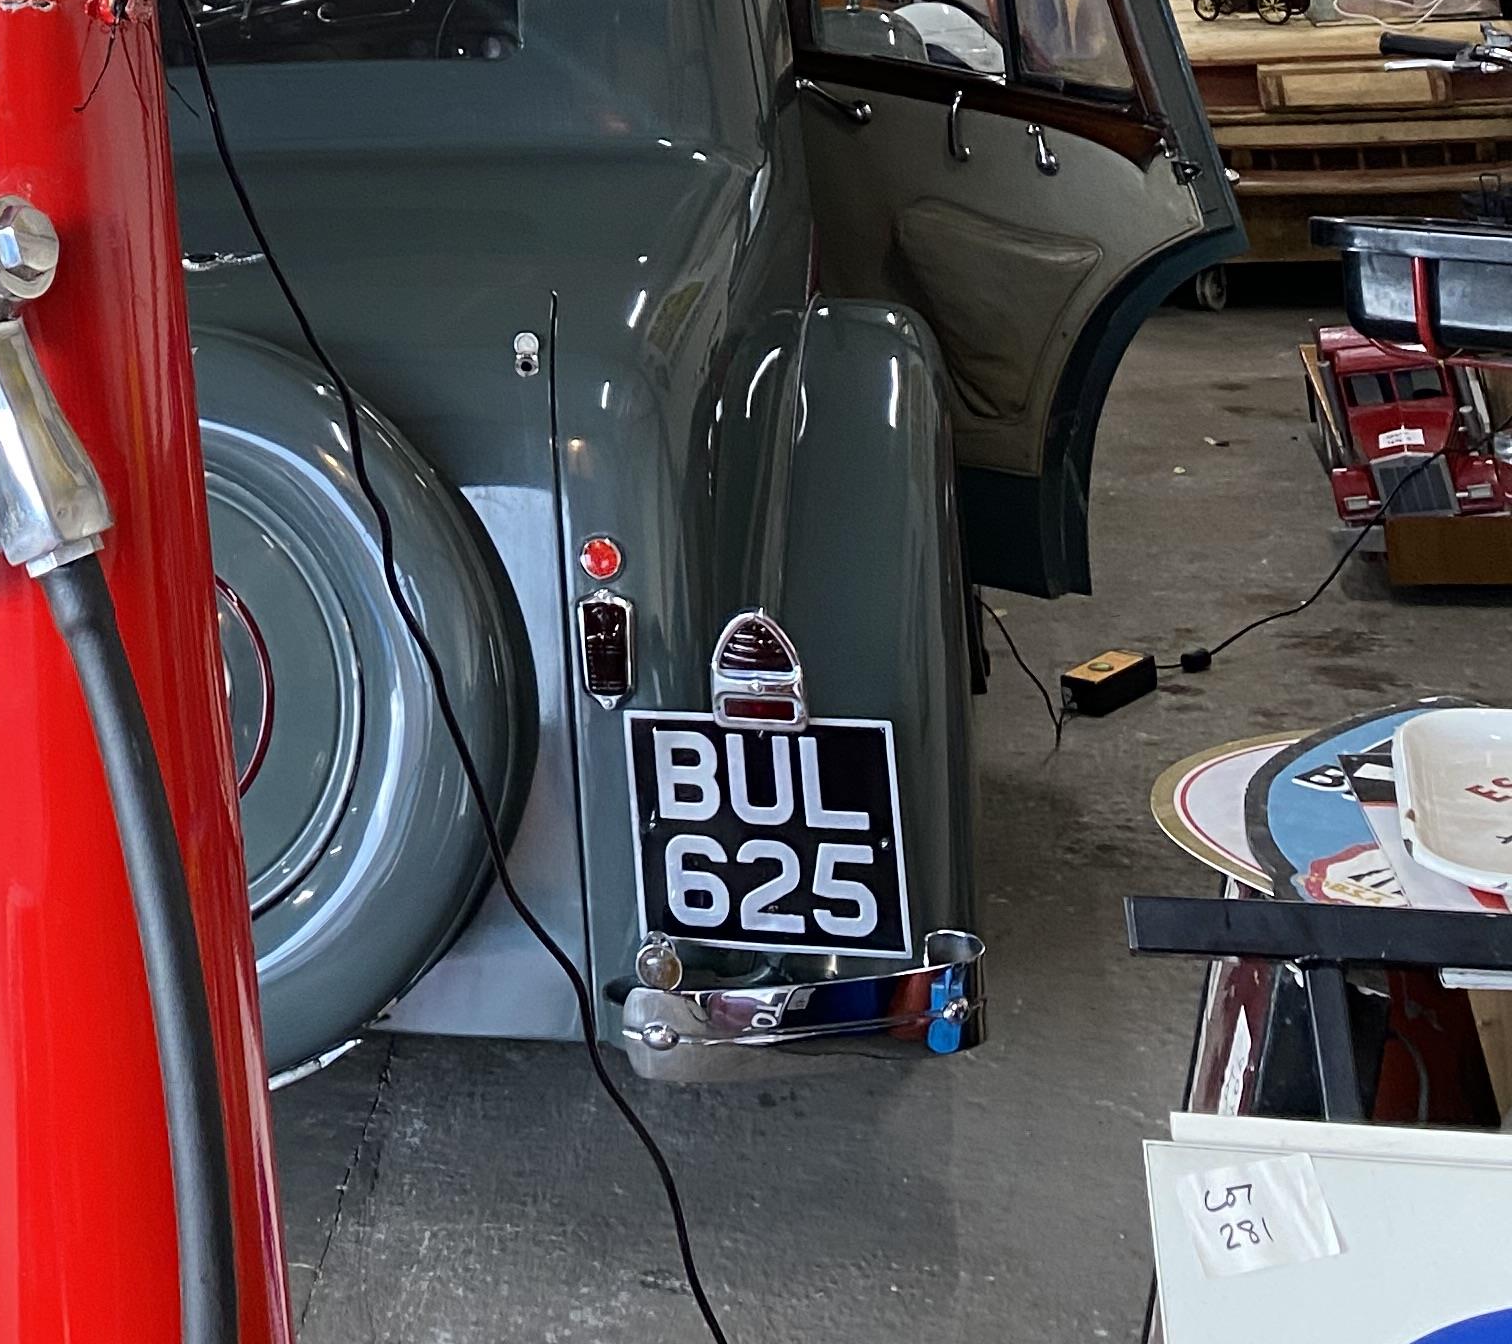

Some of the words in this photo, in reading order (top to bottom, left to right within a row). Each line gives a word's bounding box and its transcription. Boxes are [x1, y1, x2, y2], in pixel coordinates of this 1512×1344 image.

[654, 730, 871, 831] BUL
[665, 834, 879, 939] 625
[1219, 1217, 1274, 1251] 281
